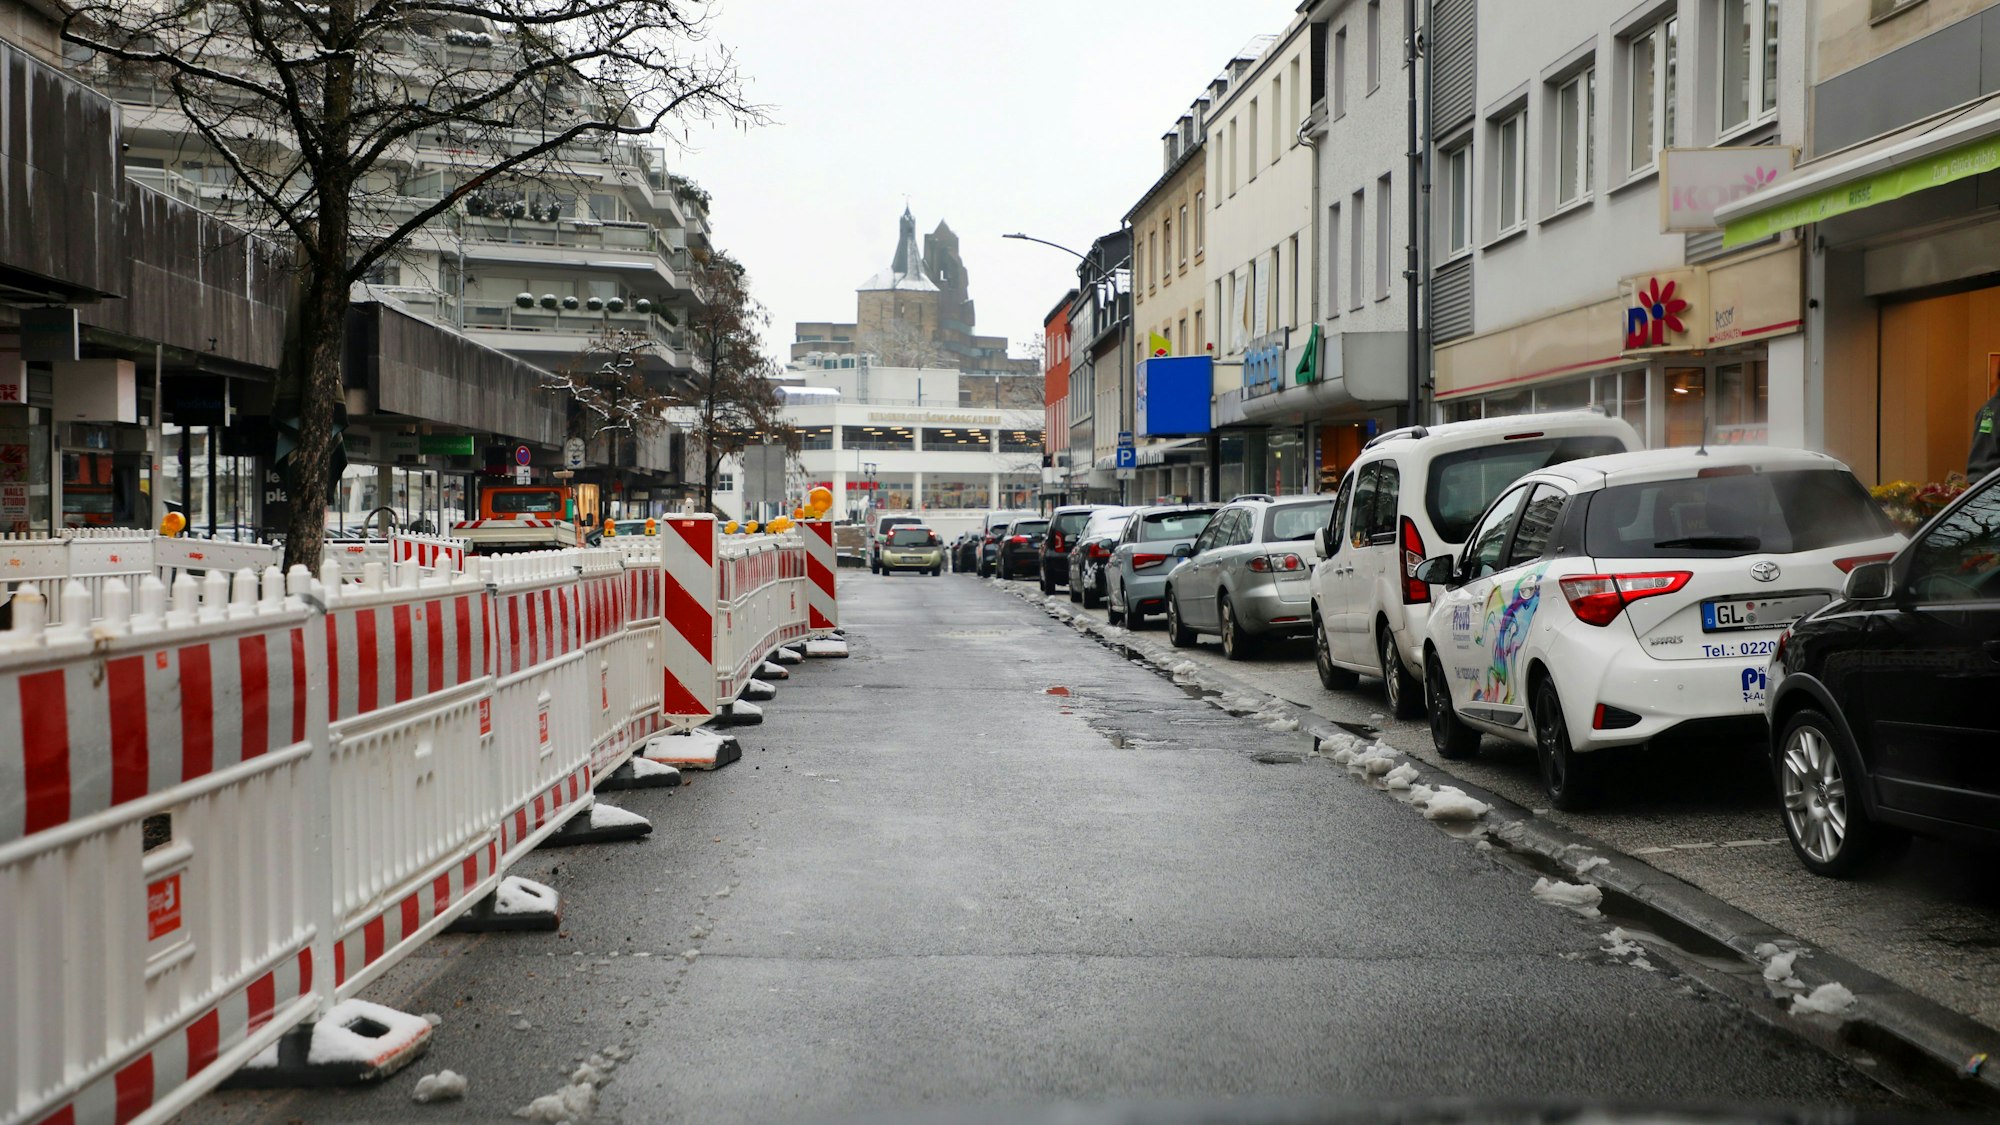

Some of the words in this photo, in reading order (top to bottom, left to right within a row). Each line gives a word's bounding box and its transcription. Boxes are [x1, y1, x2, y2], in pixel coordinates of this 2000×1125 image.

[1849, 184, 1871, 205] RISSE
[1121, 450, 1132, 466] P
[4, 487, 24, 496] NAILS
[2, 497, 26, 506] STUDIO
[1717, 604, 1744, 625] GL
[1702, 644, 1735, 658] Tel.:
